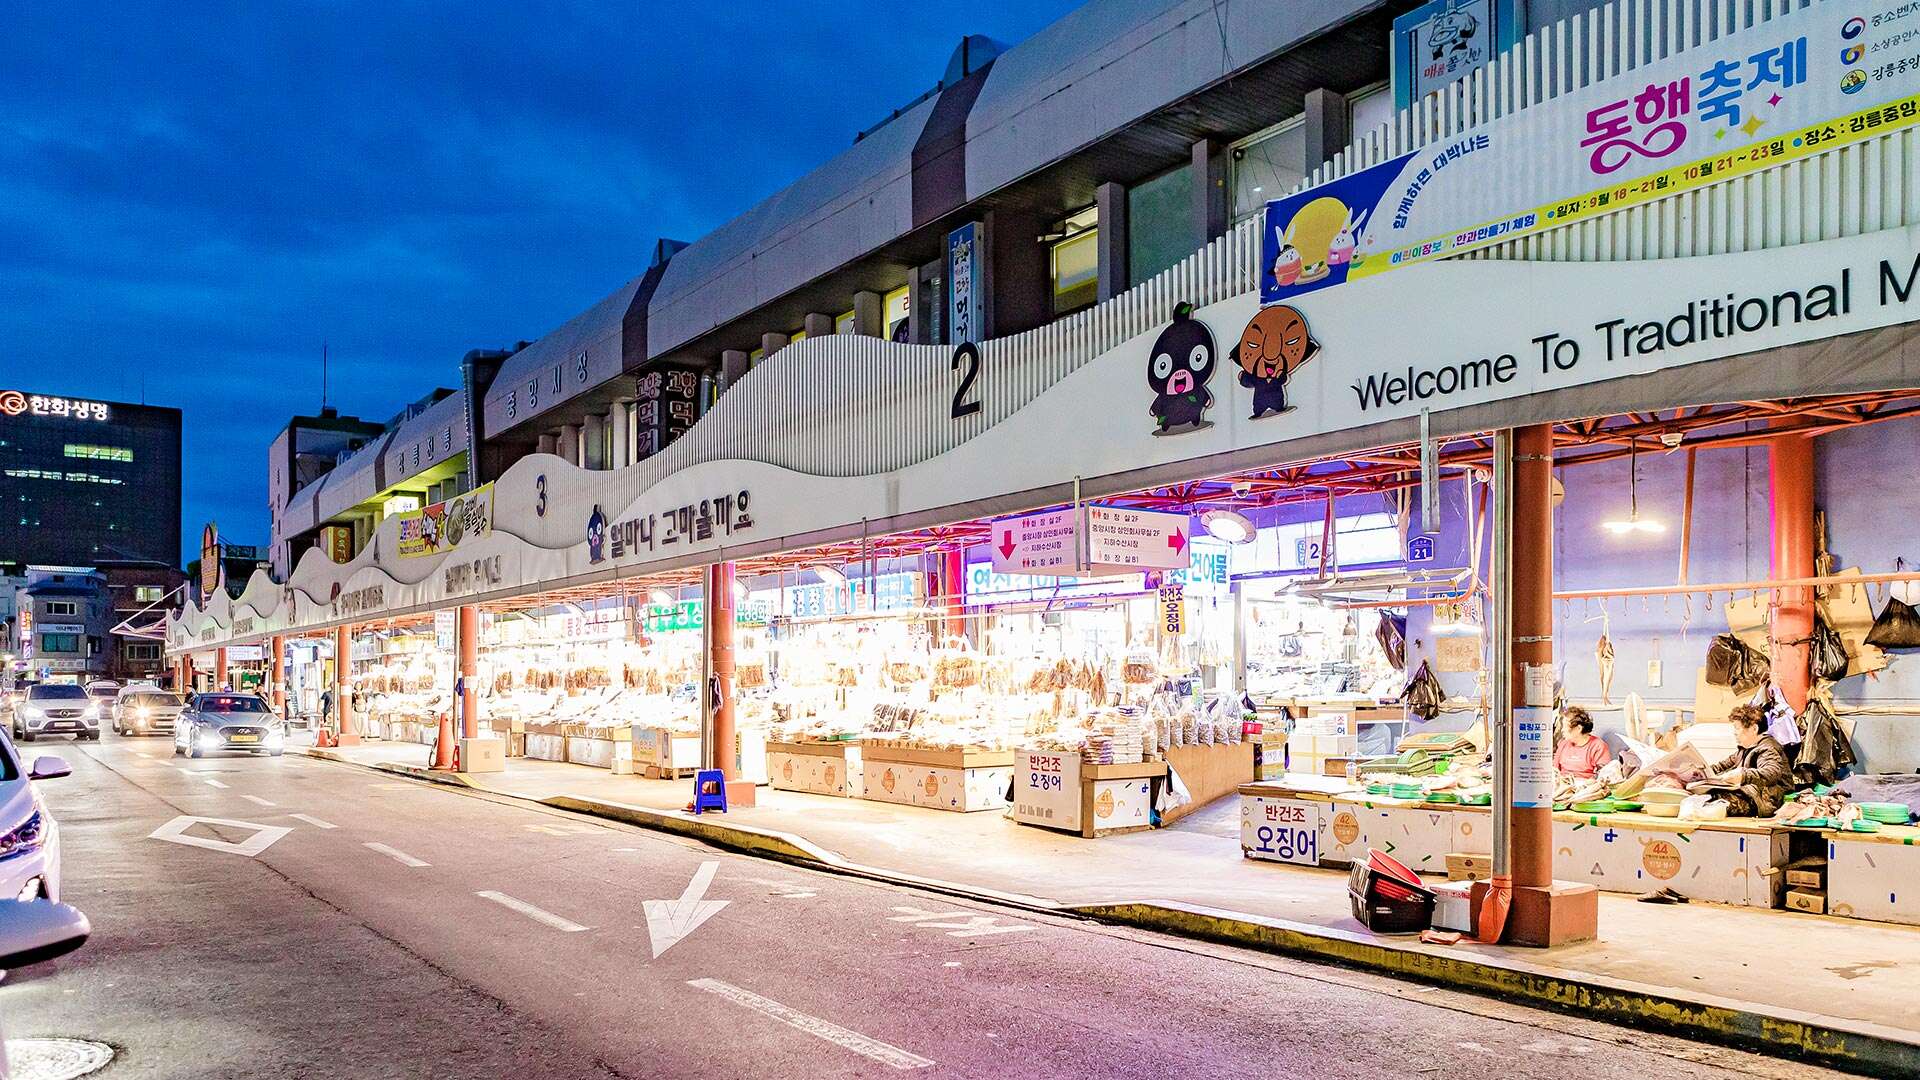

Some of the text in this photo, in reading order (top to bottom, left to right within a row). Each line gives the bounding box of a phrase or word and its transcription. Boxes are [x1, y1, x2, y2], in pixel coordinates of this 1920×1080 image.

[1393, 135, 1489, 229] 함께하면 대박나는
[1683, 161, 1712, 181] 10월
[1351, 353, 1517, 411] Welcome
[1532, 333, 1579, 373] To
[1595, 269, 1851, 361] Traditional
[507, 350, 588, 418] 중앙시장
[635, 372, 662, 400] 고향
[666, 371, 696, 398] 고향
[952, 342, 981, 419] 2
[30, 395, 108, 420] 한화생명
[535, 474, 548, 517] 3
[662, 489, 754, 544] 고마울까요
[1310, 543, 1319, 559] 2
[1414, 548, 1428, 559] 21
[1159, 587, 1183, 603] 반건조
[1167, 604, 1180, 633] 오징어
[1030, 755, 1061, 773] 반건조
[1030, 773, 1061, 791] 오징어
[1265, 804, 1306, 823] 반건조
[1256, 826, 1316, 862] 오징어
[1653, 843, 1668, 855] 44
